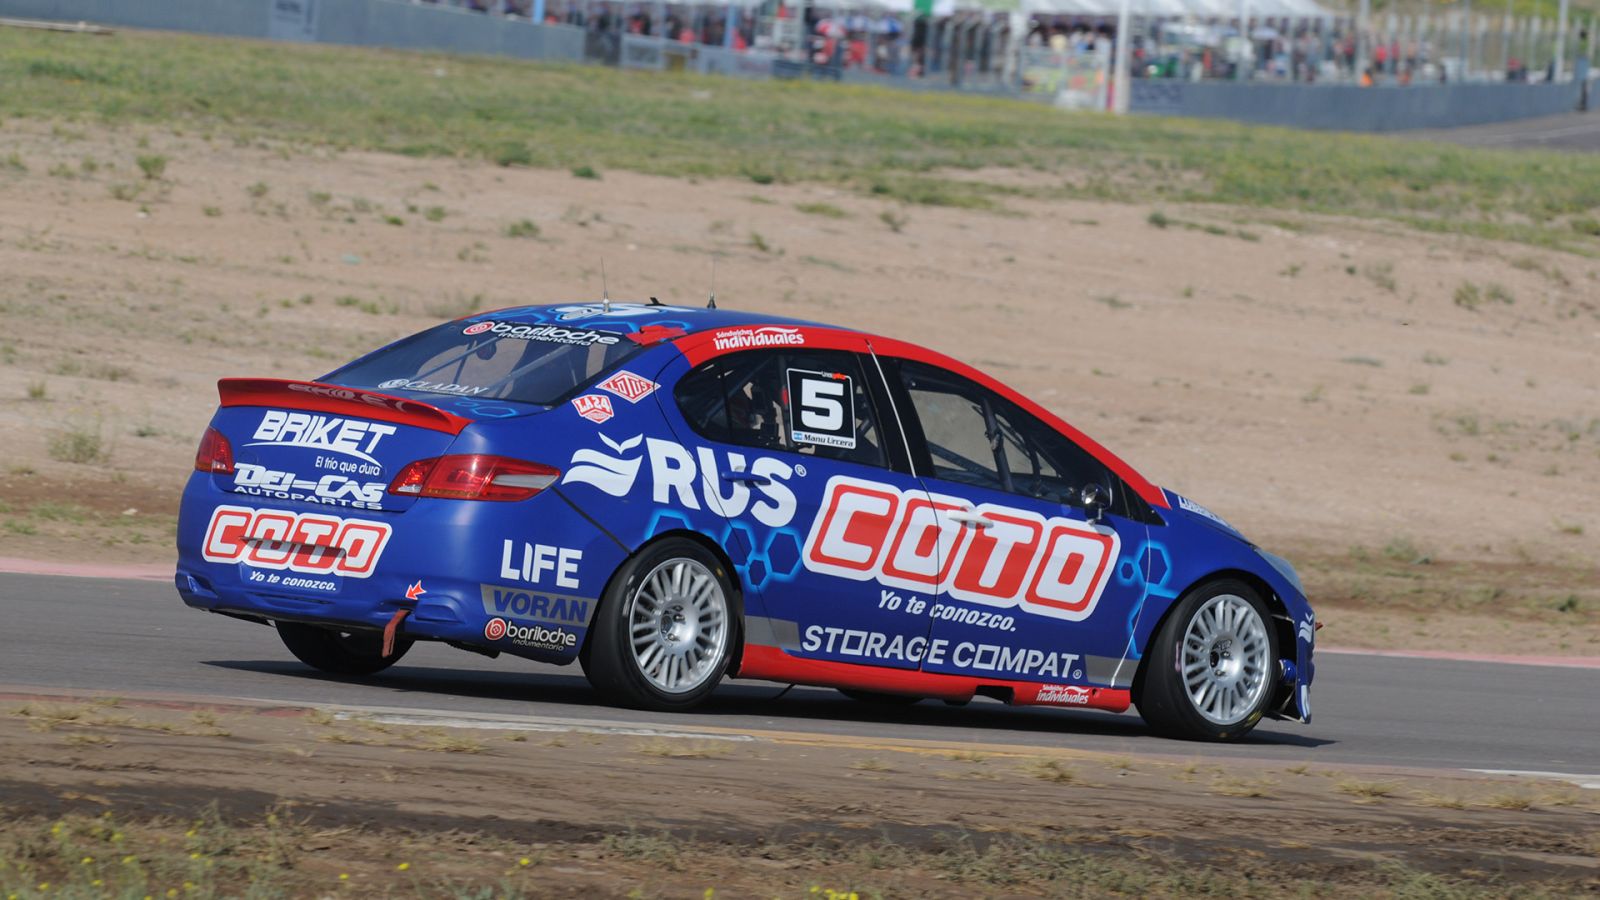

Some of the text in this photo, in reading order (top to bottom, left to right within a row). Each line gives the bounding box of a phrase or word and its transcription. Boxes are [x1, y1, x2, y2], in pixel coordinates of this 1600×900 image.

[491, 321, 620, 345] bariloche
[498, 332, 592, 346] indumentaria
[712, 331, 805, 350] individuales
[801, 378, 844, 431] 5
[252, 410, 397, 454] BRIKET
[804, 433, 826, 444] Manu
[315, 455, 381, 476] El frío que dura
[234, 486, 383, 511] AUTOPARTES
[203, 507, 391, 577] COTO
[805, 479, 1118, 617] COTO
[500, 539, 583, 589] LIFE
[250, 571, 337, 591] Yo te conozco.
[493, 590, 588, 623] VORAN
[877, 590, 1017, 632] Yo te conozco.
[506, 621, 577, 646] bariloche
[801, 625, 1080, 680] STORAGE COMPAT
[1036, 689, 1090, 705] individuales
